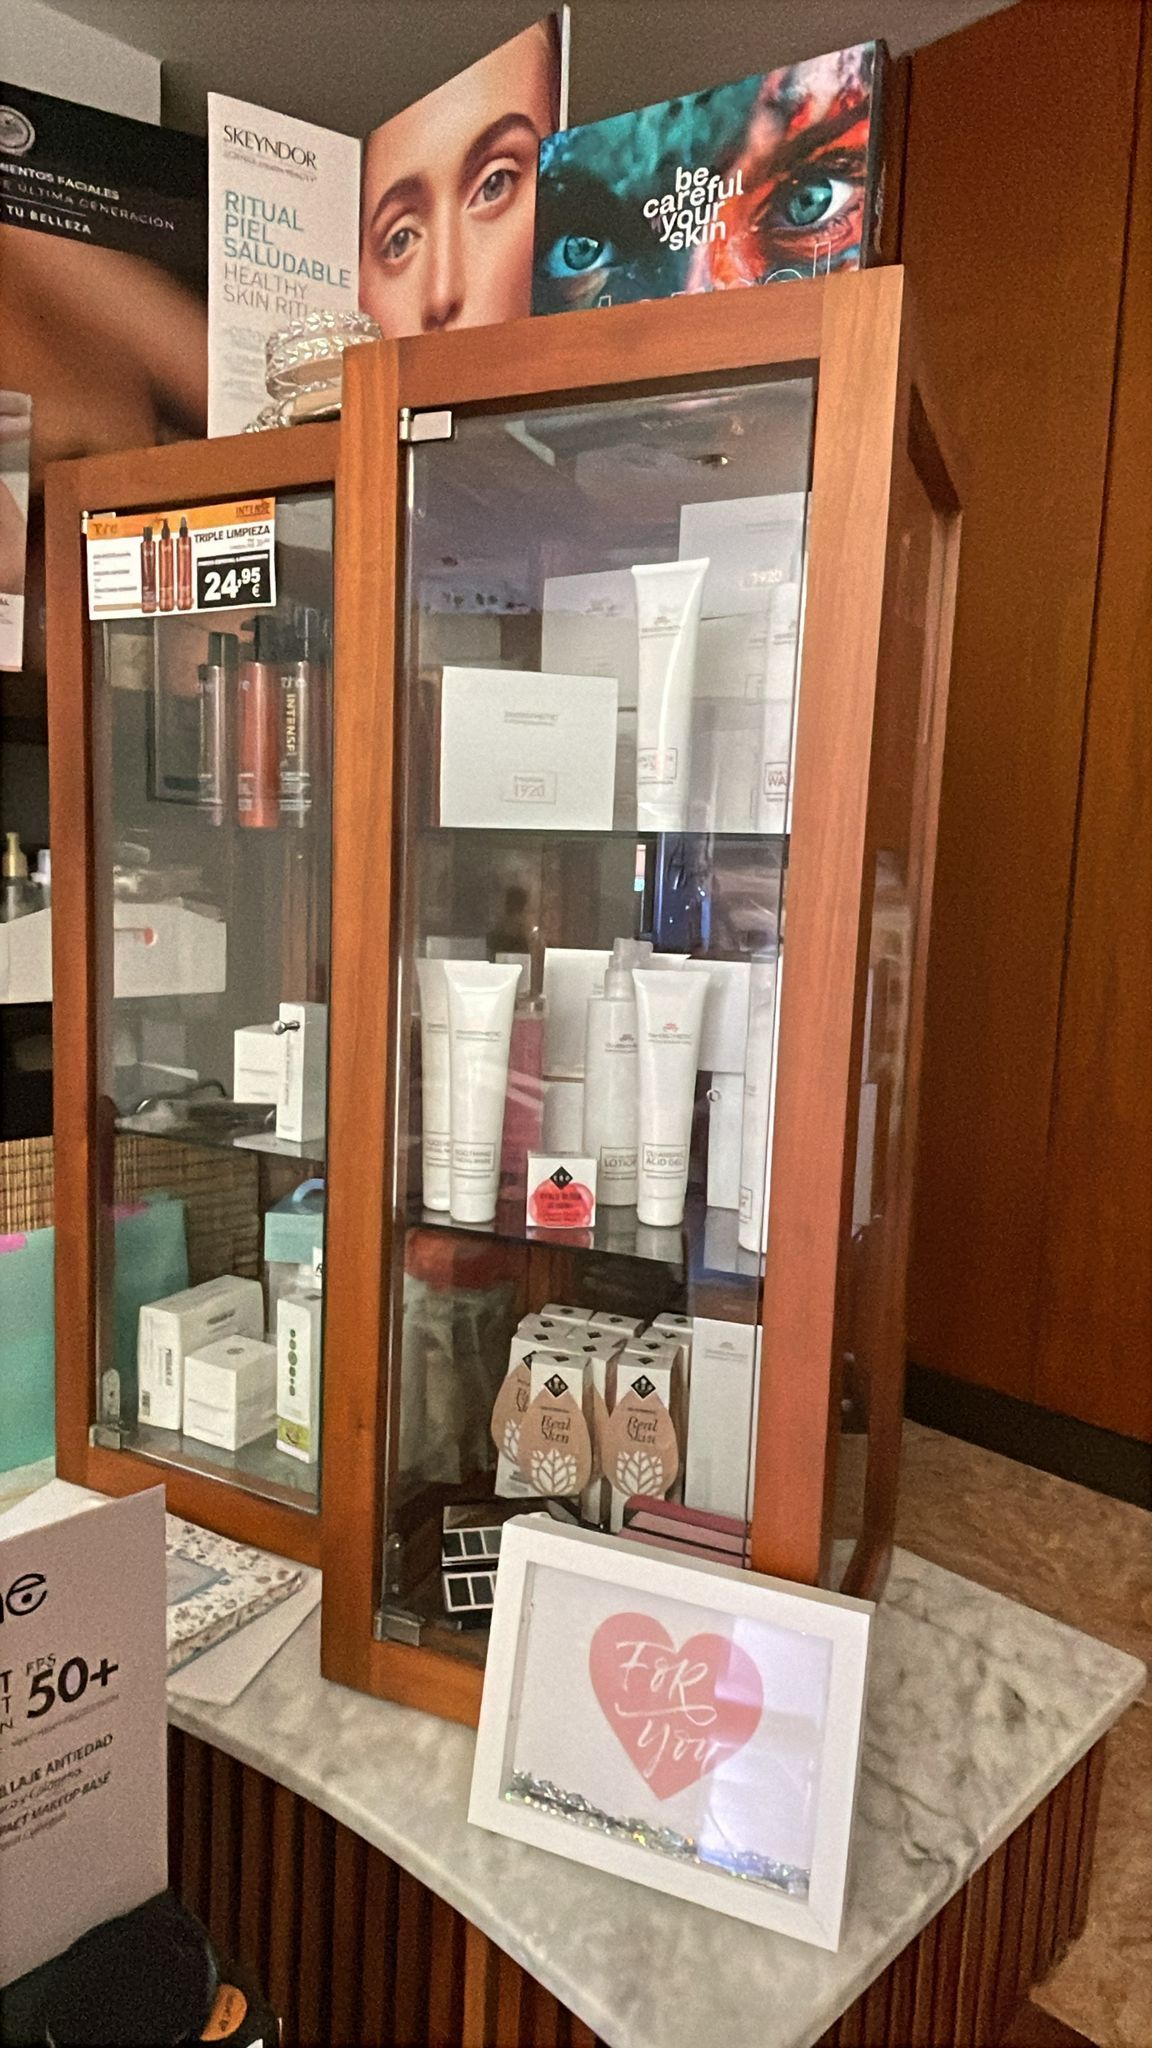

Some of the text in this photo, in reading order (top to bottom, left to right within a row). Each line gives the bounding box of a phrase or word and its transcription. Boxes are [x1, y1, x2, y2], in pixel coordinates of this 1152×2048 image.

[223, 125, 317, 170] SKEYNDOR
[57, 175, 120, 201] FACIALES
[642, 170, 744, 219] careful
[675, 166, 709, 193] be
[6, 204, 92, 235] TU BELLEZA
[225, 190, 304, 232] RITUAL
[659, 200, 726, 243] your
[225, 214, 274, 246] PIEL
[669, 219, 726, 252] skin
[224, 238, 351, 289] SALUDABLE
[224, 262, 308, 298] HEALTHY
[223, 285, 270, 312] SKIN
[195, 525, 271, 544] TRIPLE LIMPIEZA
[204, 566, 261, 601] 24,95
[26, 1653, 57, 1677] FPS
[26, 1656, 119, 1719] 50+
[46, 1733, 113, 1775] ANTIEDAD
